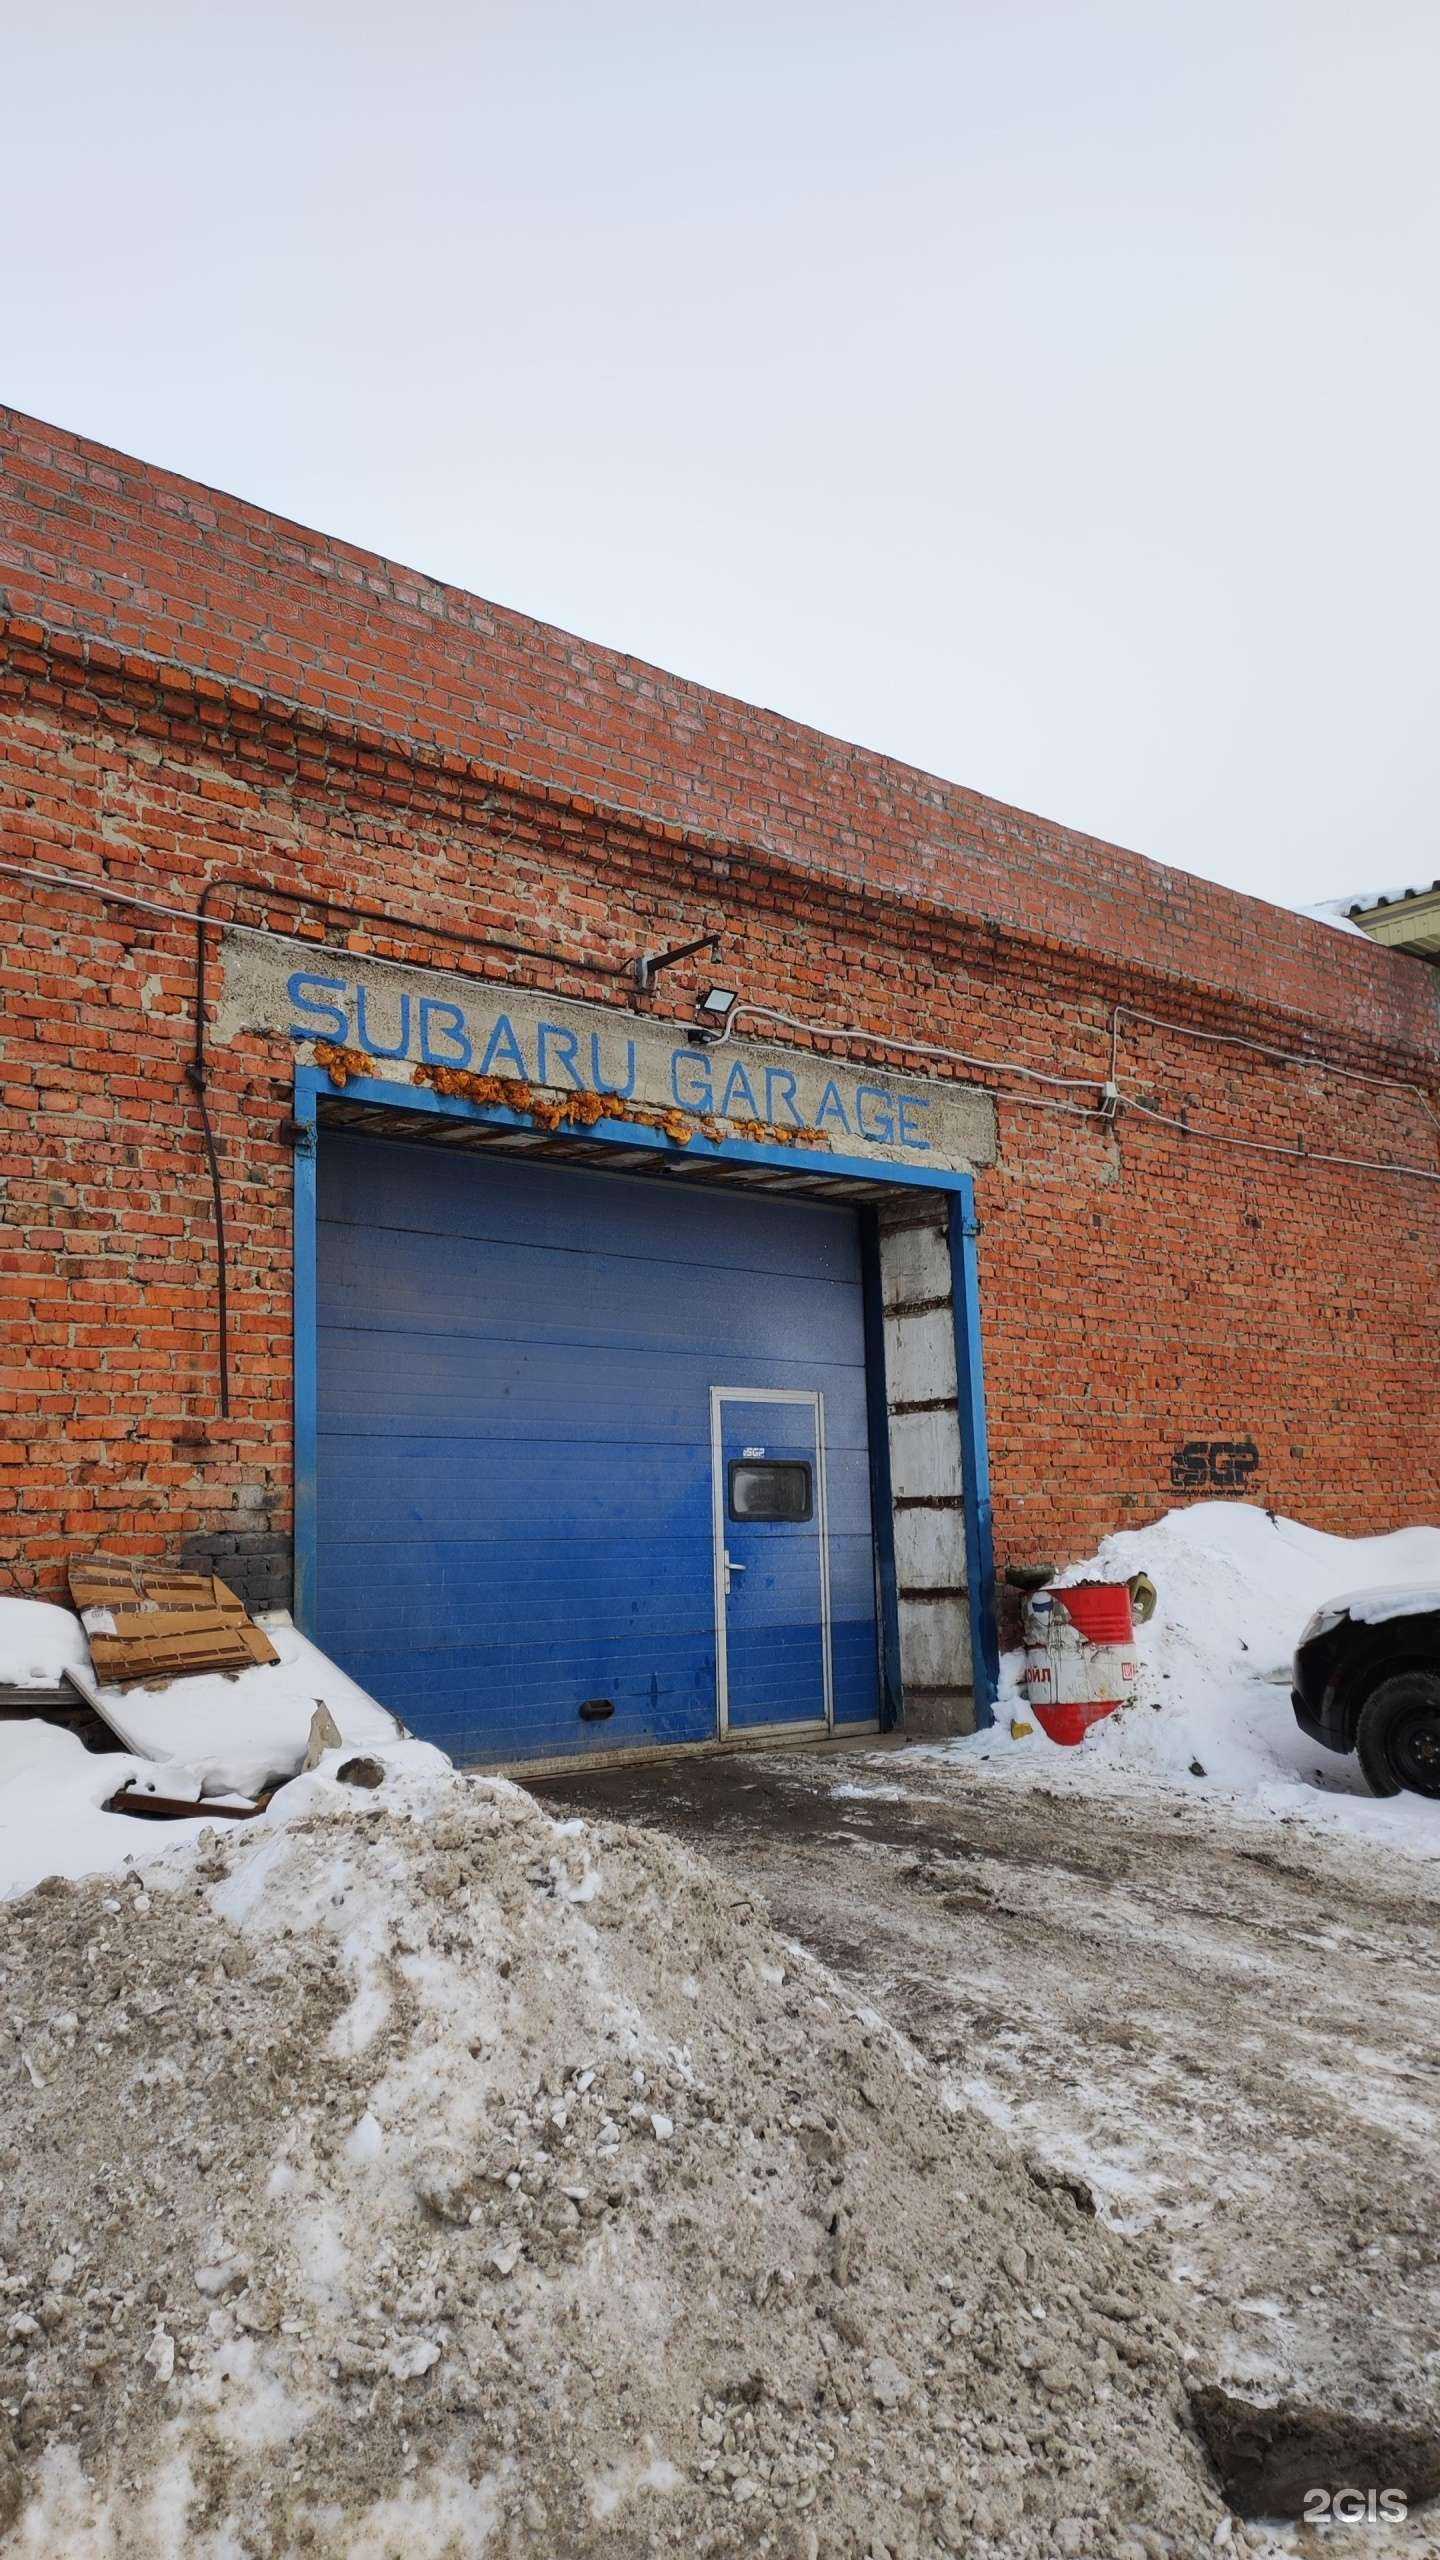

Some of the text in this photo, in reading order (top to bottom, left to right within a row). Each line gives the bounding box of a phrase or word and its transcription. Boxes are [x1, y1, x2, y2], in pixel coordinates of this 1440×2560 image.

[287, 971, 931, 1150] SUBARU GARAGE
[1024, 1665, 1051, 1683] ОЙЛ
